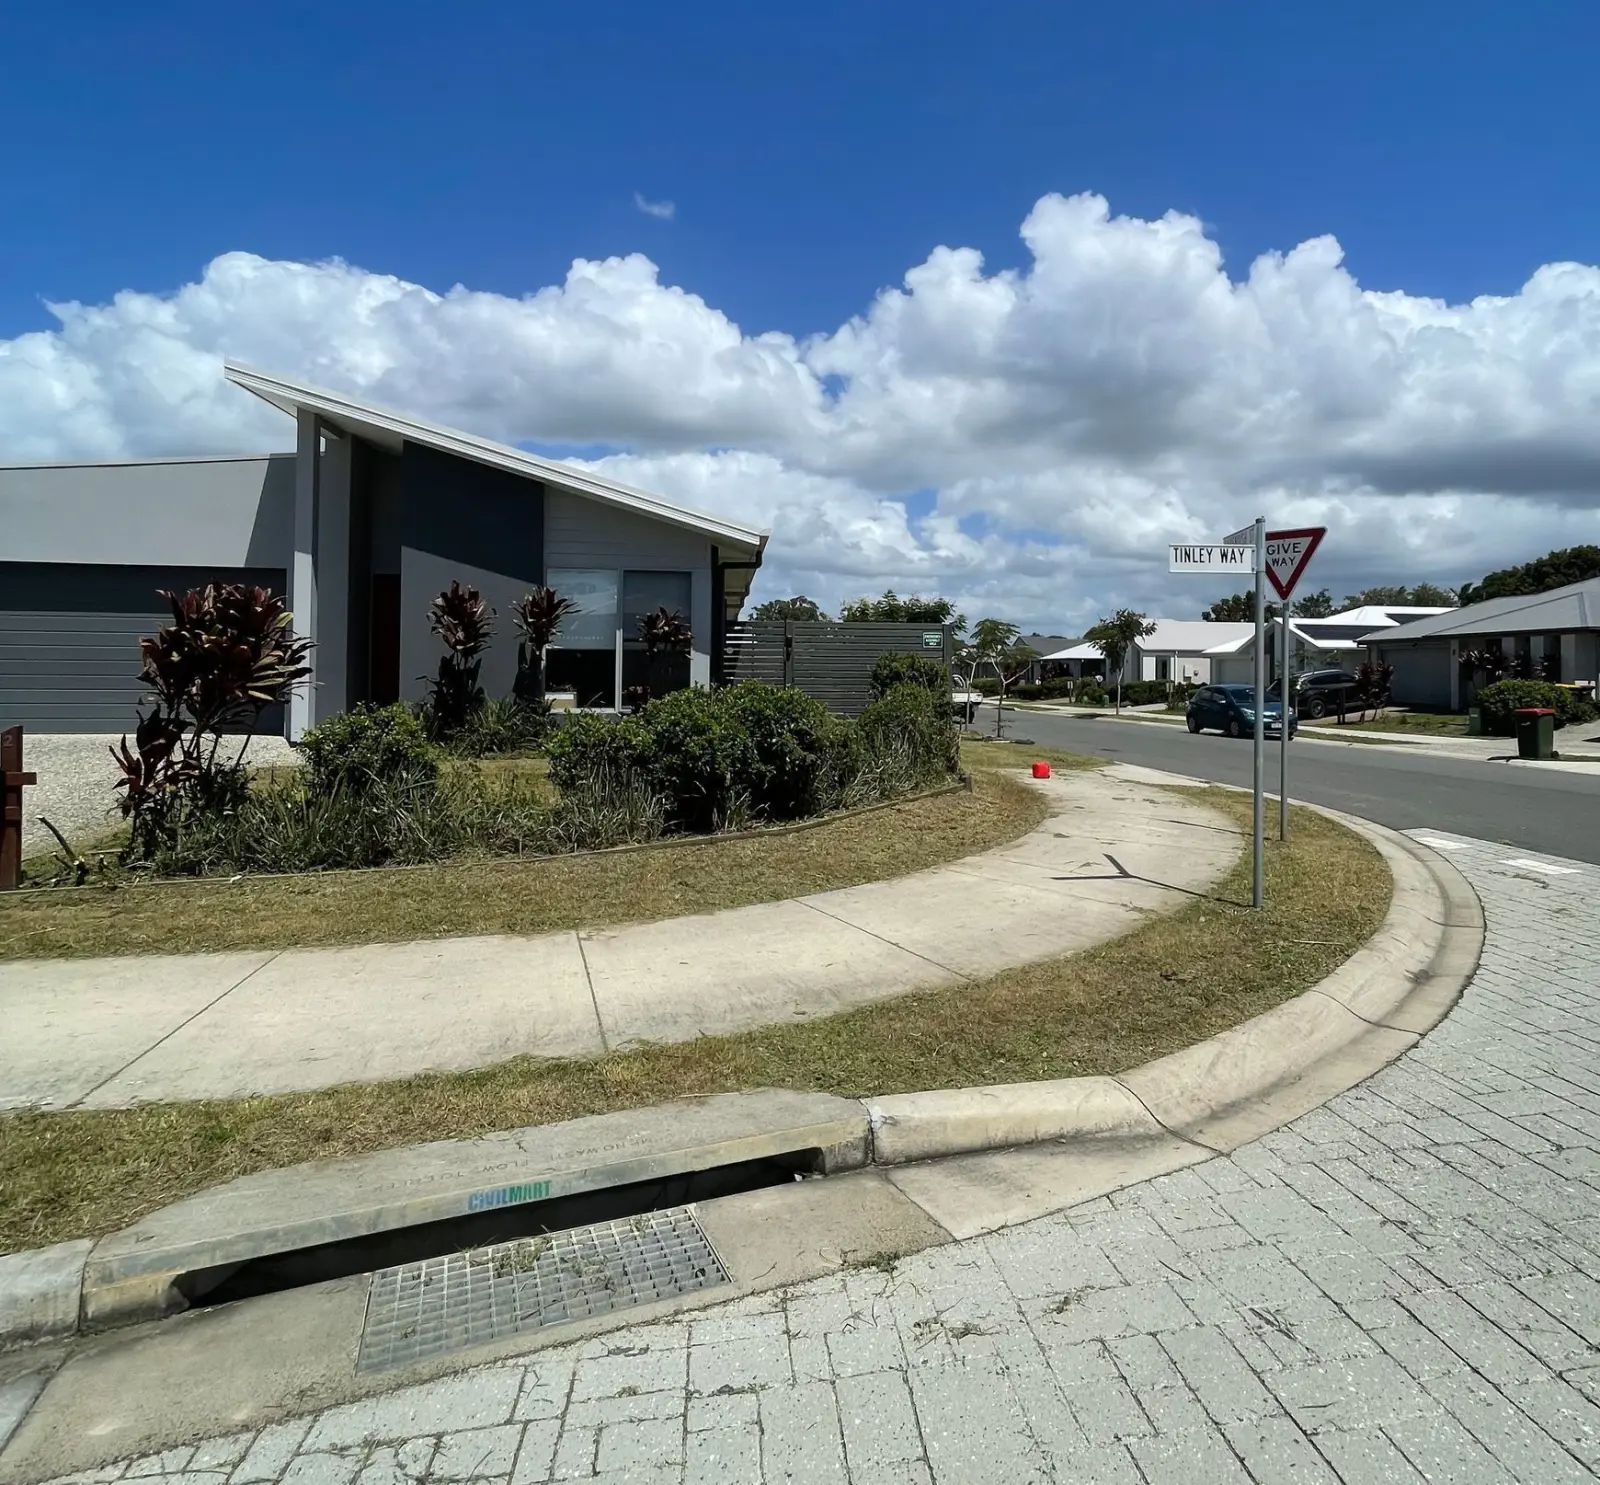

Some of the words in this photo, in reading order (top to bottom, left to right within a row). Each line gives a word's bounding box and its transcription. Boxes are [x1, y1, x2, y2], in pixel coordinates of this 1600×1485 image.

[1173, 547, 1213, 564] TINLEY
[1220, 548, 1245, 564] WAY
[1266, 542, 1302, 556] GIVE
[1272, 556, 1296, 567] WAY
[468, 1180, 551, 1211] CIVILMART
